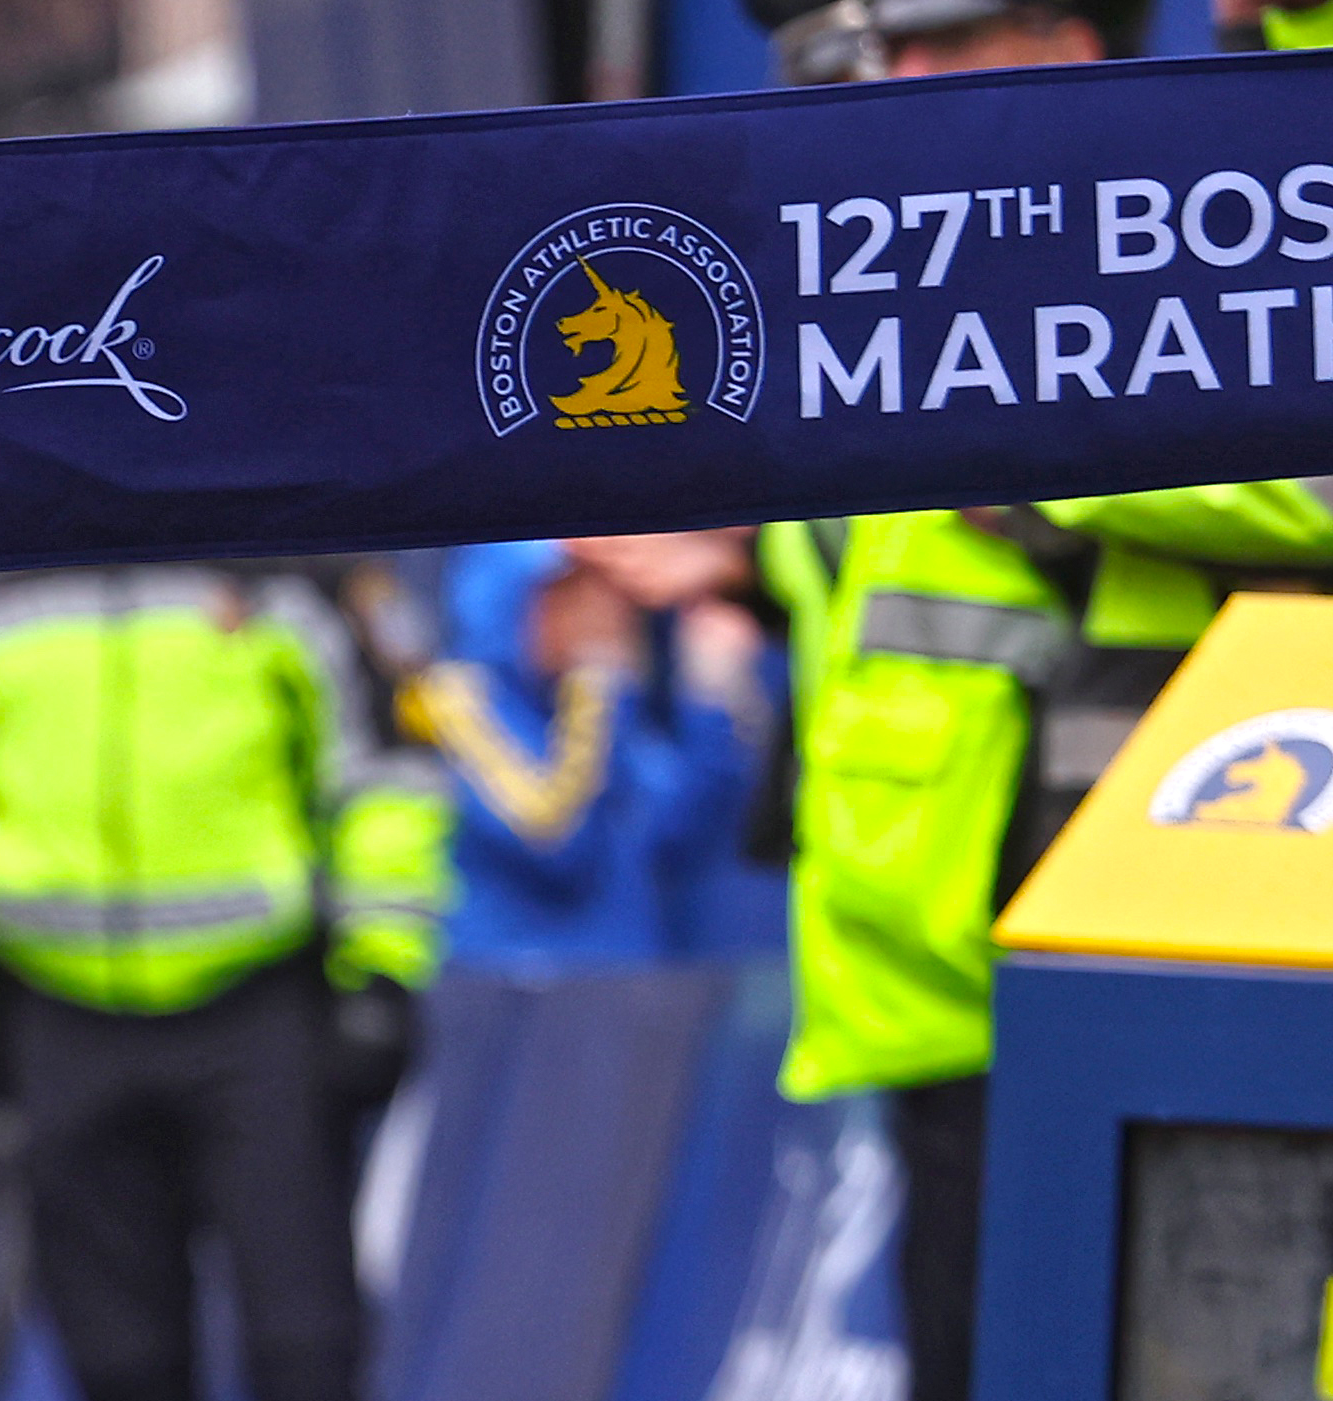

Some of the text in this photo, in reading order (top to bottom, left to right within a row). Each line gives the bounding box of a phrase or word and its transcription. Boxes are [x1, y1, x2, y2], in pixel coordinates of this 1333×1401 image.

[779, 163, 1333, 296] 127TH BOS
[490, 217, 753, 418] BOSTON ATHLETIC ASSOCIATION
[798, 284, 1333, 419] MARAT
